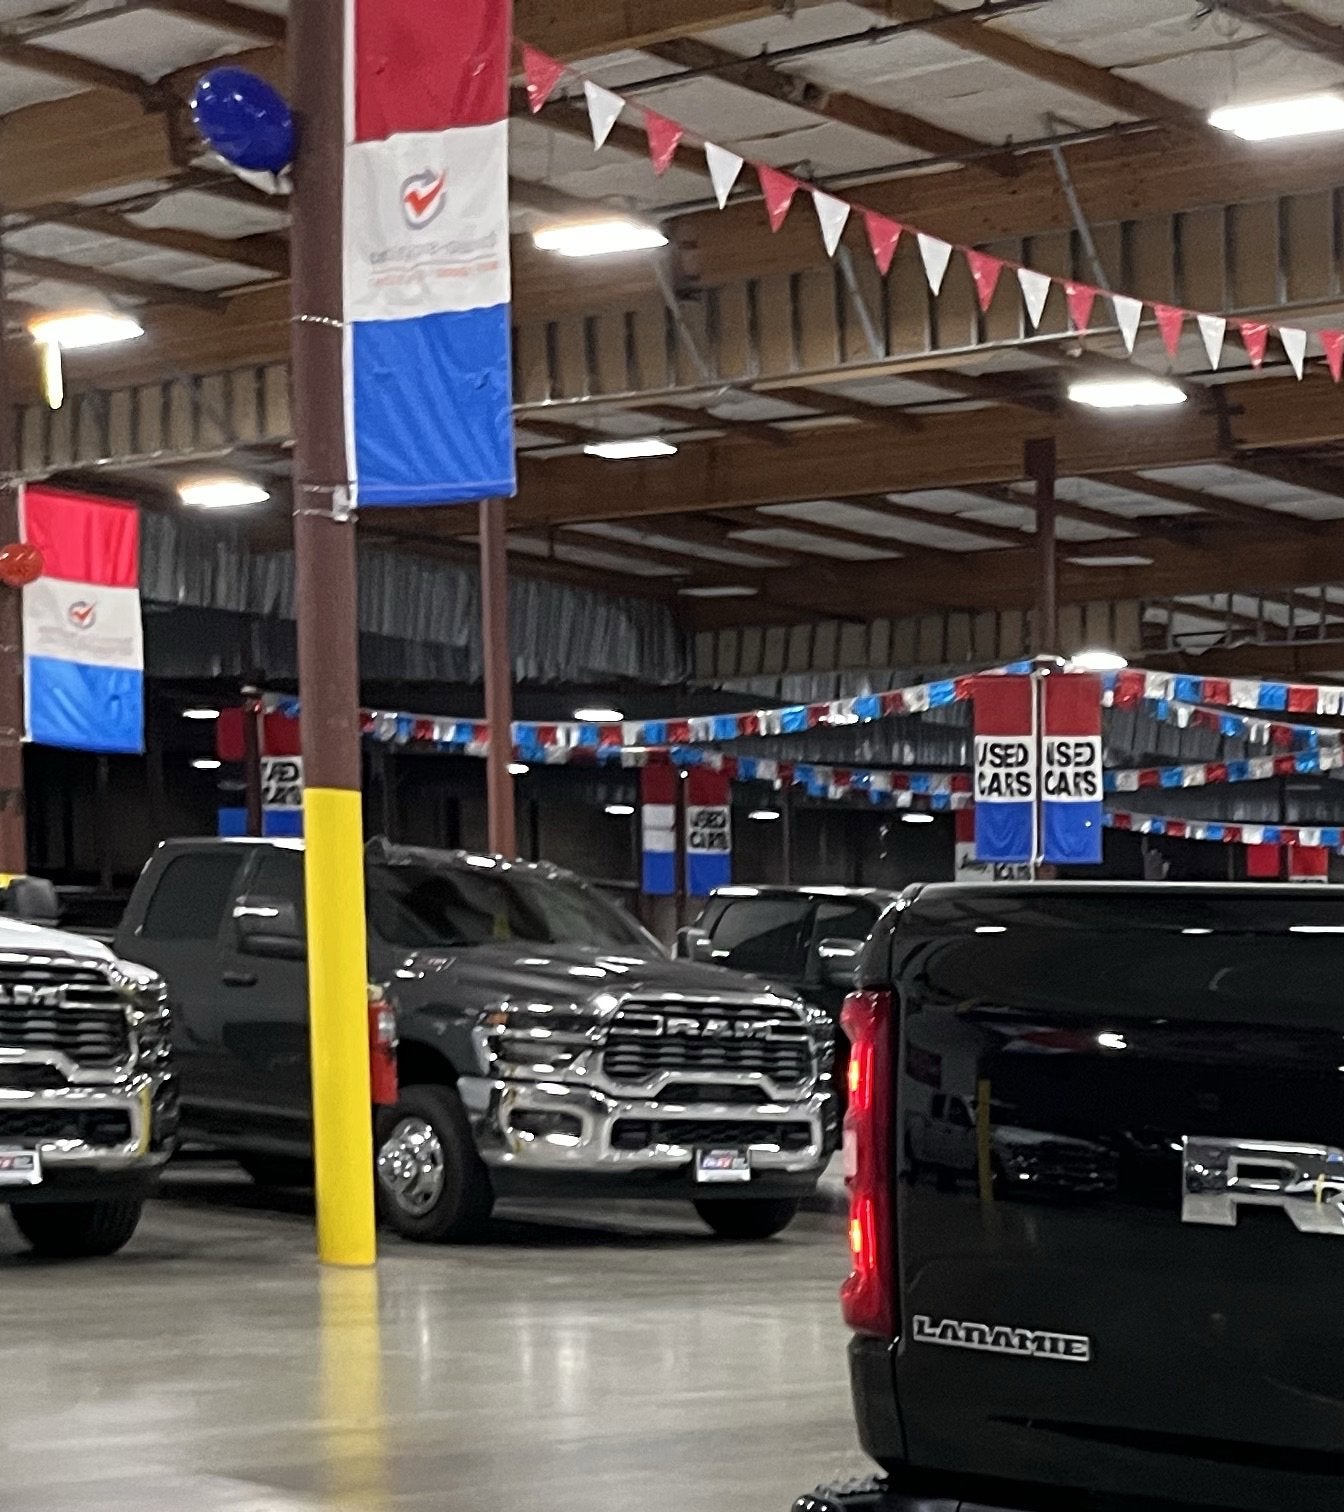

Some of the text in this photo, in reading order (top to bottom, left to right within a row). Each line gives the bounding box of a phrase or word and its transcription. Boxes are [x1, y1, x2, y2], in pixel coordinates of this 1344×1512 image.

[976, 742, 1030, 768] USED
[1046, 742, 1095, 767] USED
[978, 771, 1032, 797] CARS
[1045, 770, 1097, 797] CARS
[913, 1314, 1090, 1362] LARAMIE
